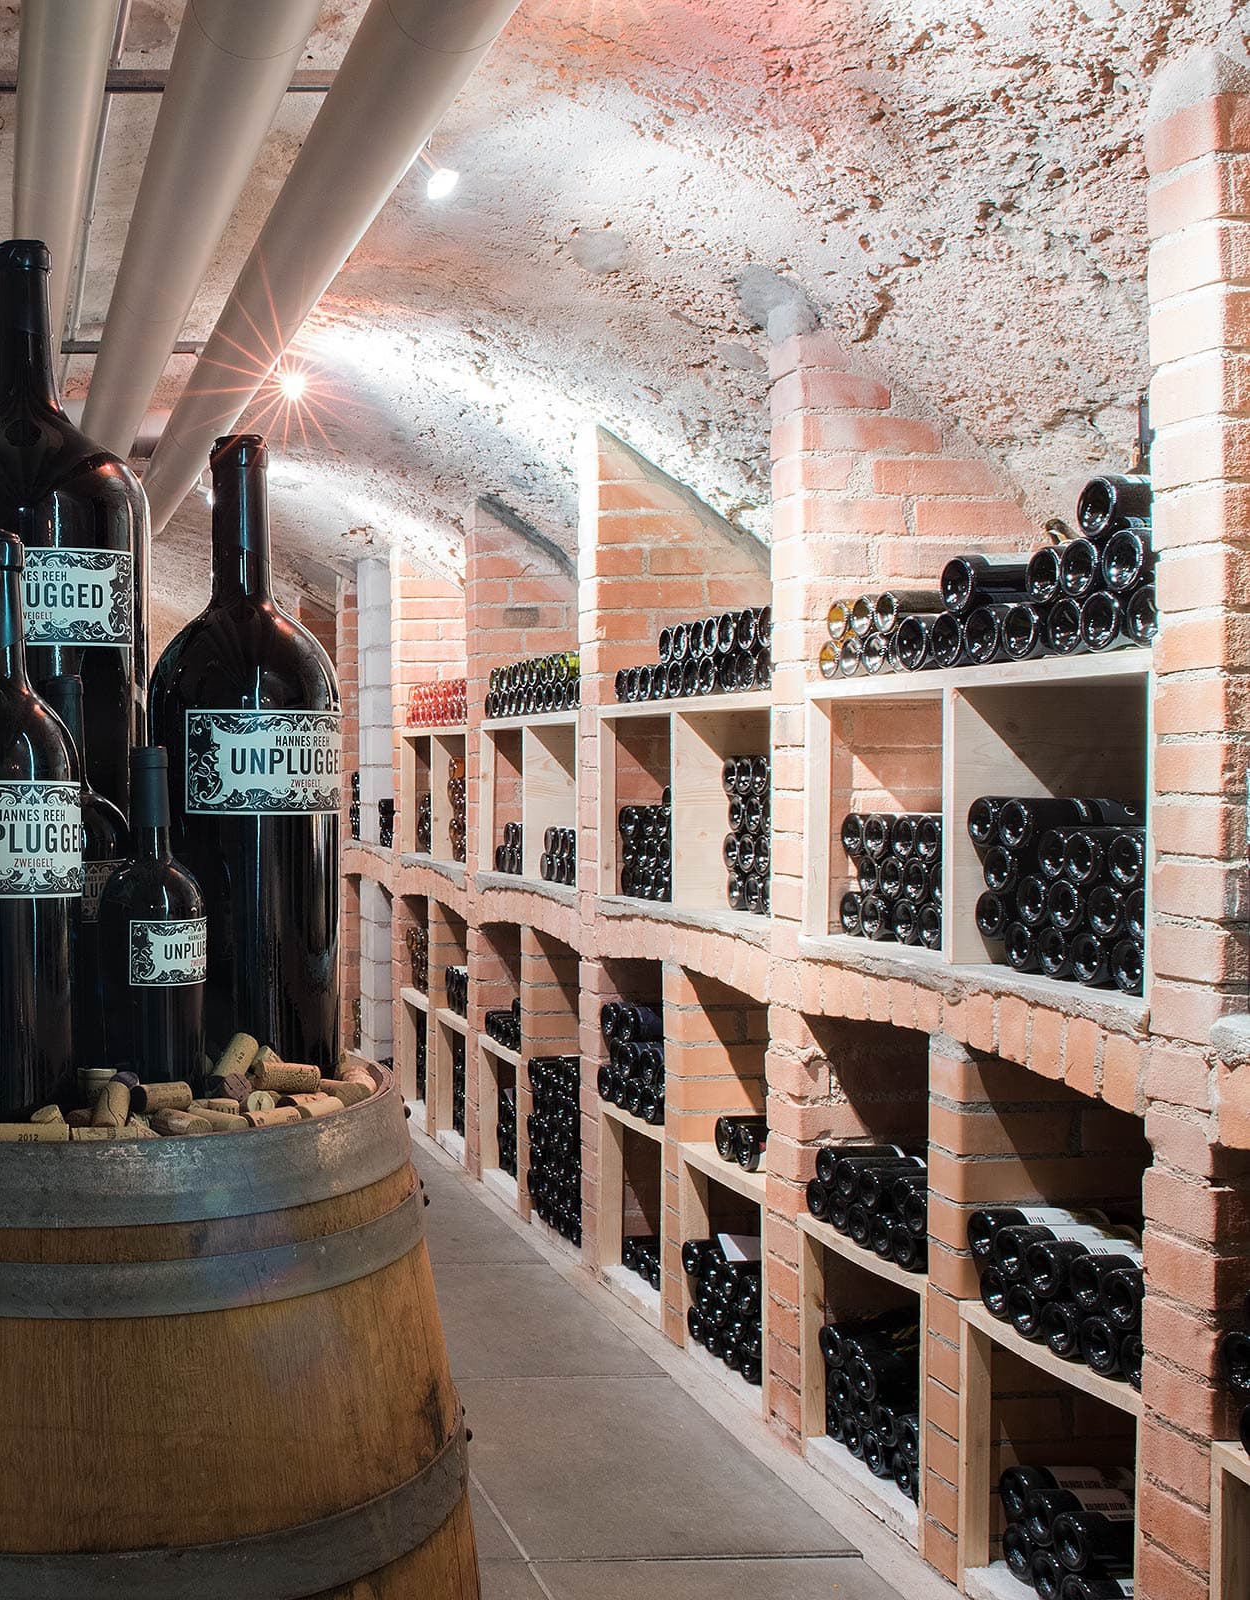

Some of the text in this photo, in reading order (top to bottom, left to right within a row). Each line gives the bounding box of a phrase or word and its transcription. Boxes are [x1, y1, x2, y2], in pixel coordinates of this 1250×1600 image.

[21, 571, 67, 581] NES REEH
[22, 611, 53, 620] WEIGELT
[275, 735, 330, 747] HANNES REEH
[230, 748, 341, 775] UNPLUGGE
[290, 779, 321, 788] ZWEIGELT
[43, 810, 66, 822] REEH
[14, 858, 54, 868] ZWEIGELT
